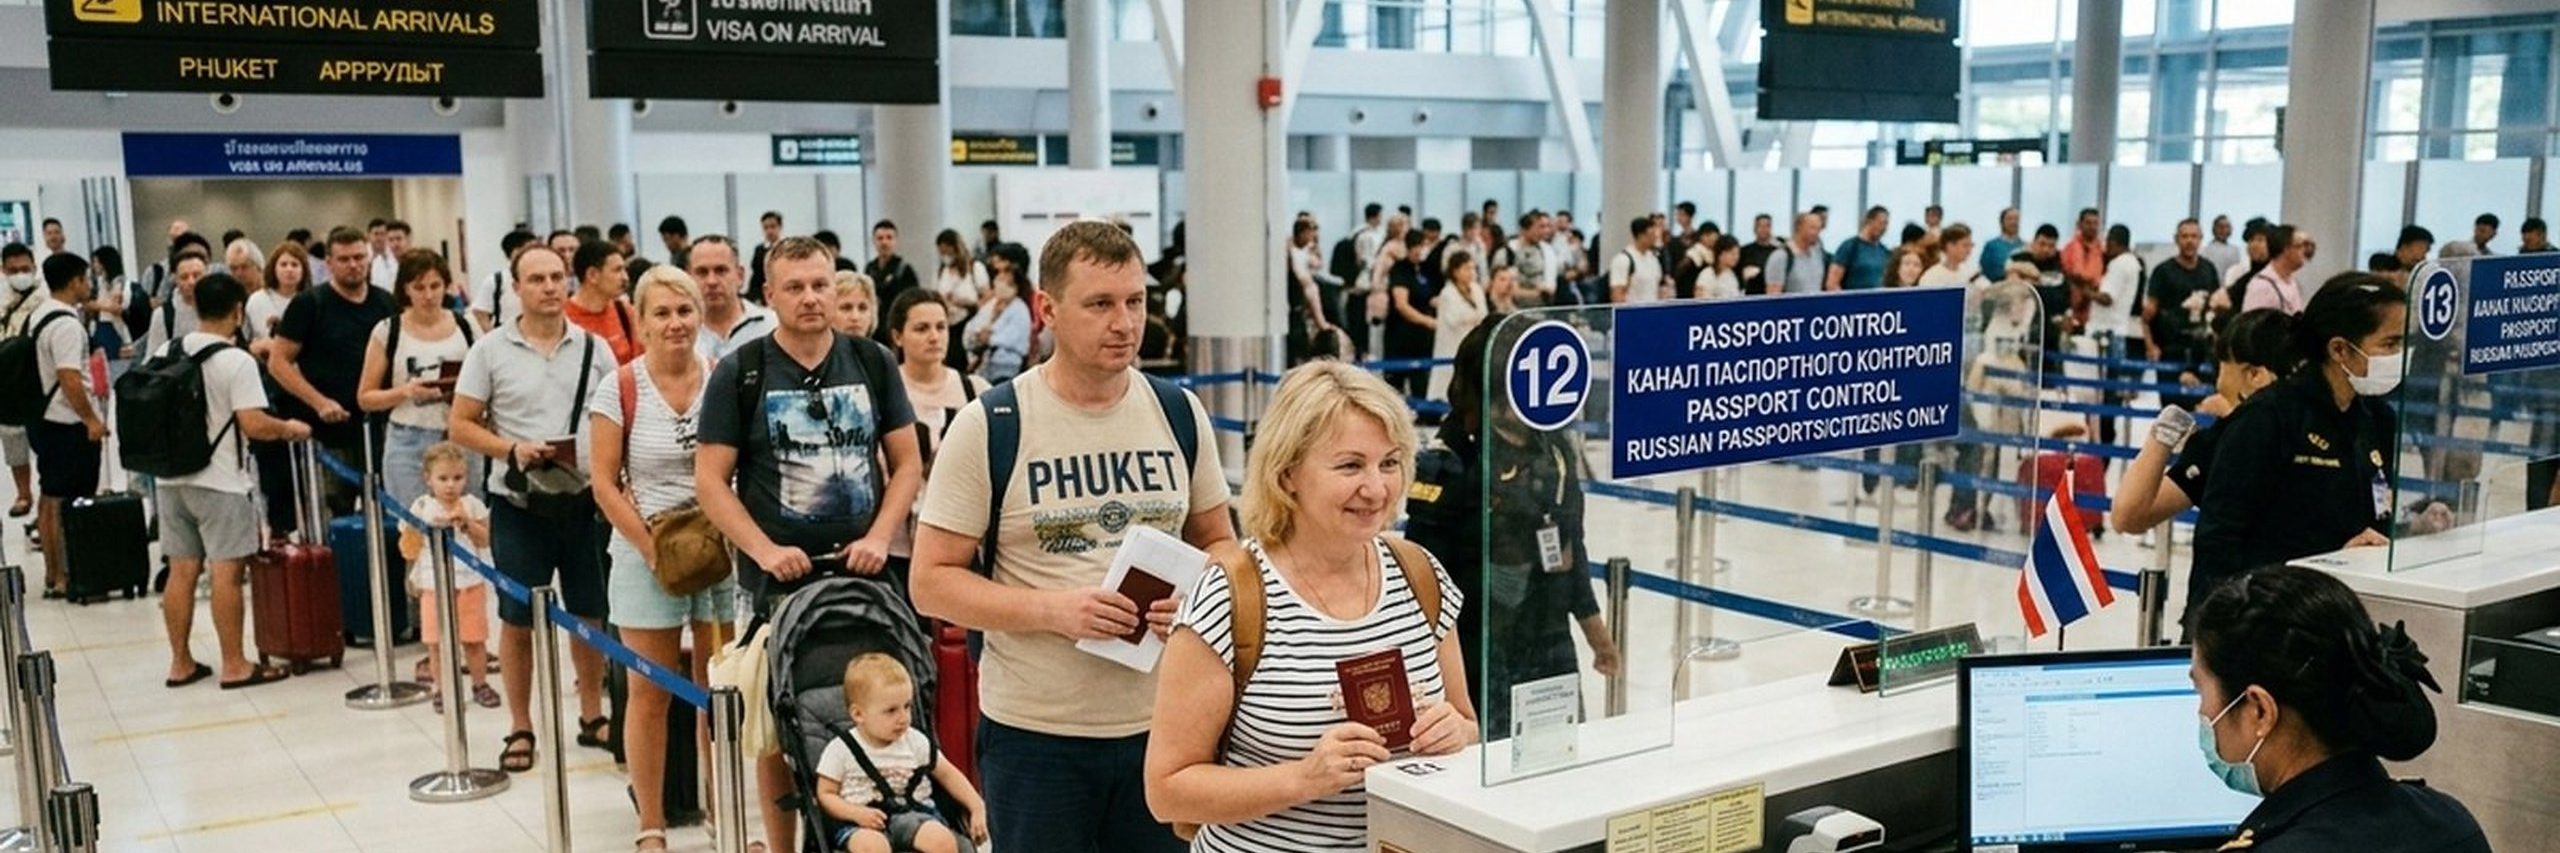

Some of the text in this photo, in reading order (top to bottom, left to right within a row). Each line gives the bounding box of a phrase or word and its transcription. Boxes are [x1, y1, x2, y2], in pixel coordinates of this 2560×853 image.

[156, 1, 496, 35] INTERNATIONAL ARRIVALS
[706, 19, 758, 42] VISA
[760, 21, 794, 43] ON
[797, 23, 886, 46] ARRIVAL
[179, 57, 279, 80] PHUKET
[2425, 284, 2453, 324] 13
[1689, 310, 1907, 352] PASSPORT CONTROL
[1518, 343, 1581, 409] 12
[1627, 341, 1953, 395] КАНАЛ ПАСПОРТНОГО КОНТРОЛЯ
[1687, 378, 1902, 424] PASSPORT CONTROL
[1627, 432, 1713, 463] RUSSIAN
[1907, 403, 1950, 428] ONLY
[1028, 451, 1178, 504] PHUKET
